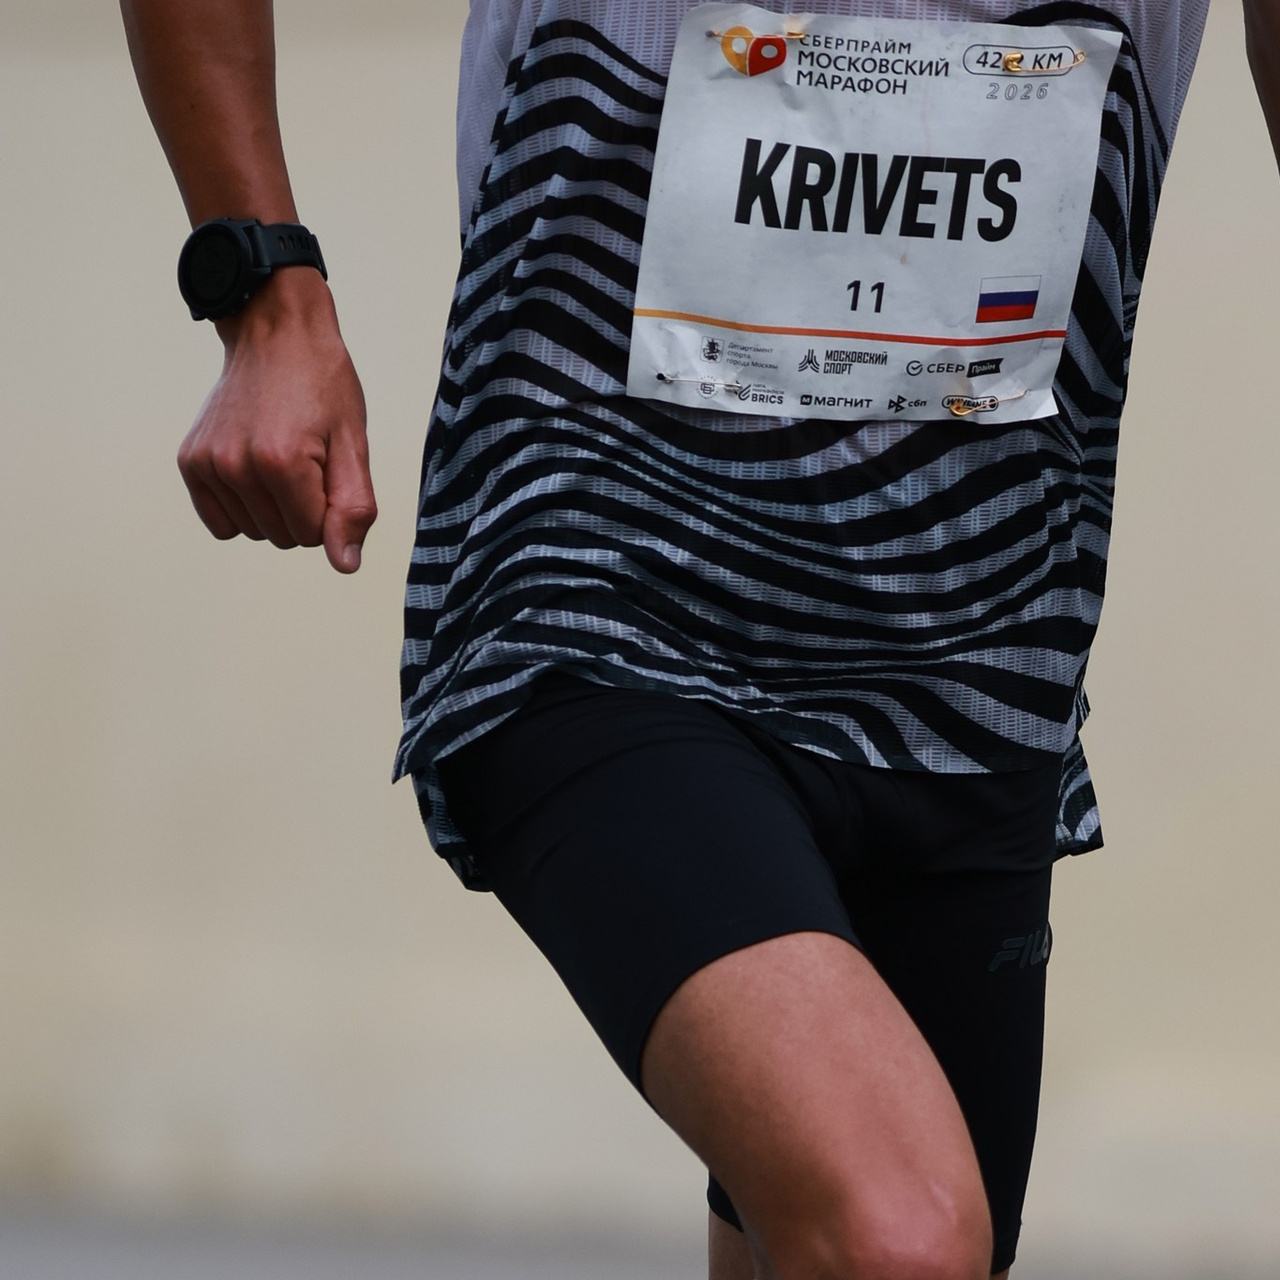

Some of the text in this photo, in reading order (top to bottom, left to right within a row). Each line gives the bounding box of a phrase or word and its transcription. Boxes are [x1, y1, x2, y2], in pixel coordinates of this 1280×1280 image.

[800, 34, 911, 55] СБЕРПРАЙМ
[797, 50, 950, 77] МОСКОВСКИЙ
[796, 70, 908, 95] МАРАФОН
[986, 82, 1049, 100] 2026
[733, 137, 1022, 243] KRIVETS
[846, 280, 885, 314] 11
[824, 349, 888, 366] МОСКОВСКИЙ
[823, 362, 853, 375] СПОРТ
[926, 362, 996, 374] СБЕР Прайм
[751, 393, 784, 405] BRICS
